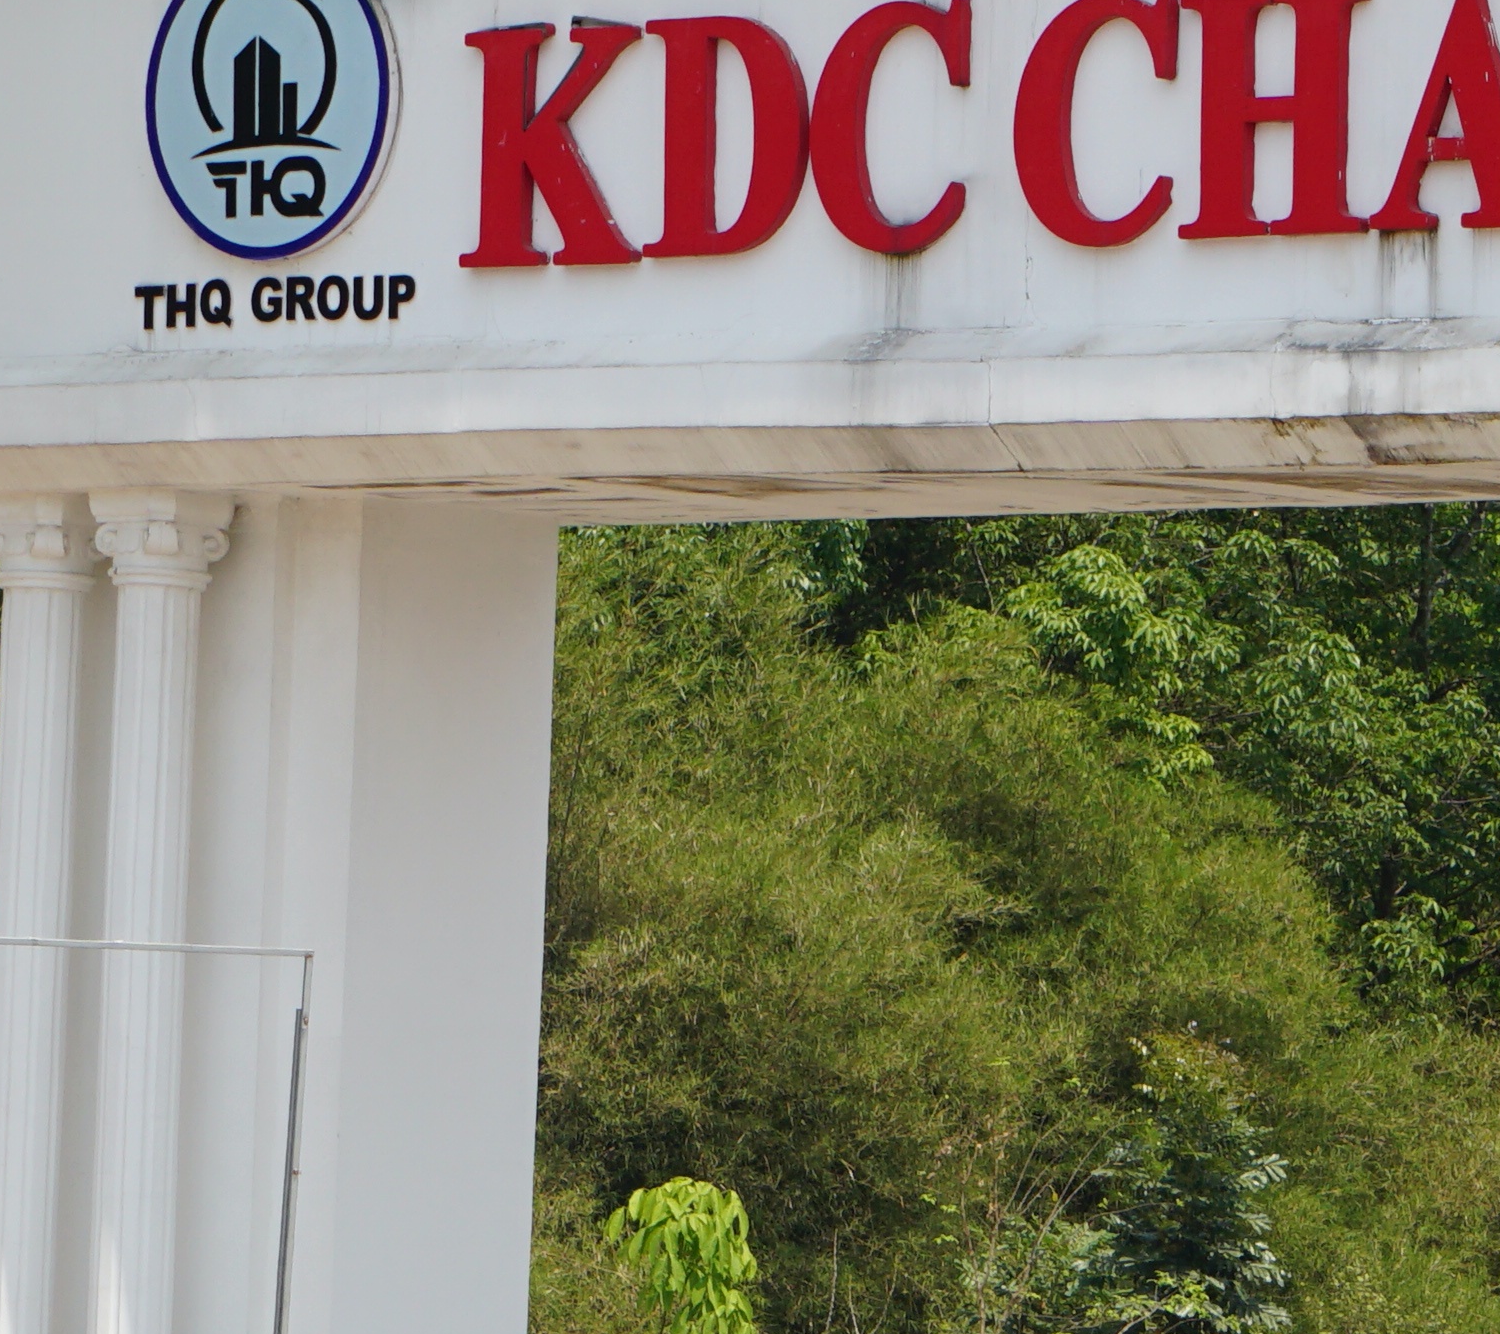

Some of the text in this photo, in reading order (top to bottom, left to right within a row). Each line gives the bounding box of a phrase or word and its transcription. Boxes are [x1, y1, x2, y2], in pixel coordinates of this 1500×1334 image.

[206, 156, 325, 219] THQ
[134, 274, 417, 330] THQ GROUP
